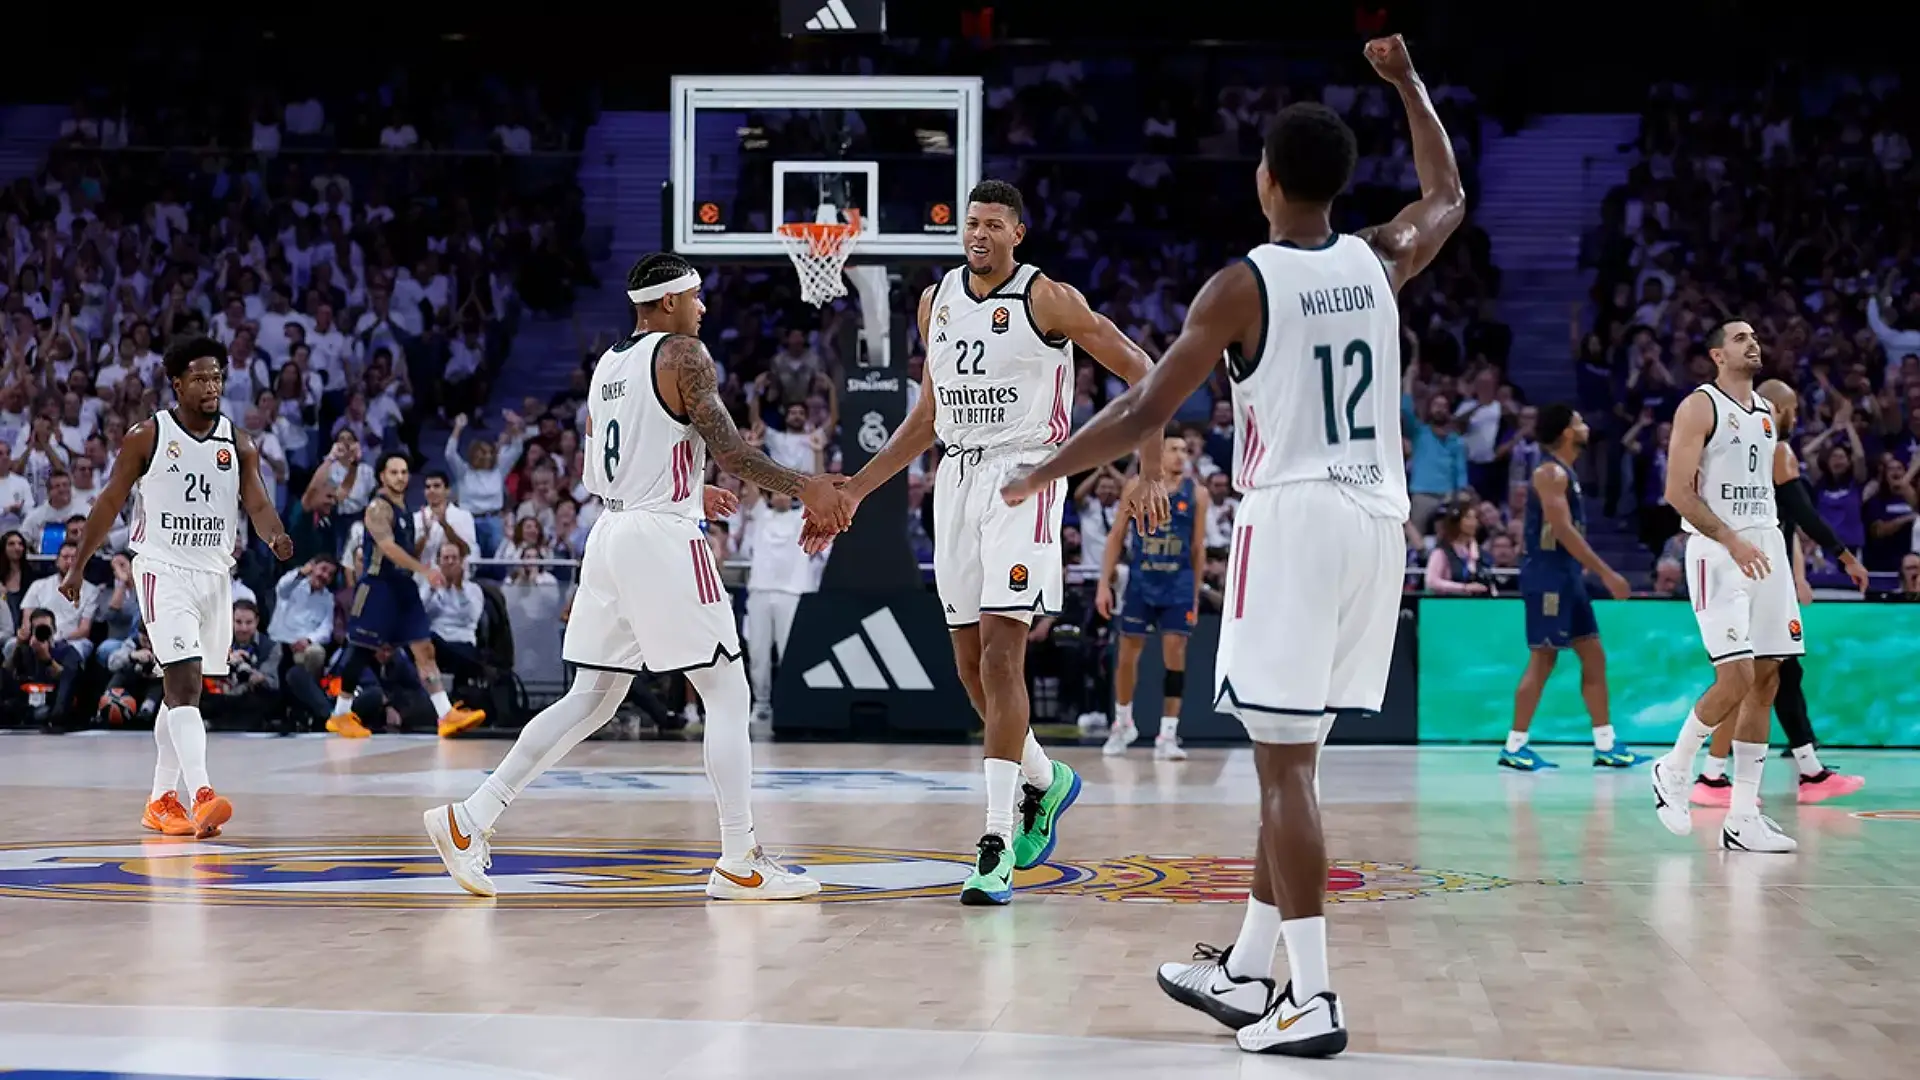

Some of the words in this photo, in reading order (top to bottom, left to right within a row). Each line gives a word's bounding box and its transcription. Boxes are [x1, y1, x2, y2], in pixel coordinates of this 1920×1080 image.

[1299, 285, 1376, 317] MALEDON
[955, 340, 986, 375] 22
[938, 385, 1019, 406] Emirates
[1314, 338, 1376, 445] 12
[952, 408, 964, 424] LY
[967, 406, 1005, 424] BETTER
[604, 419, 620, 483] 8
[1748, 444, 1758, 472] 6
[184, 473, 211, 503] 24
